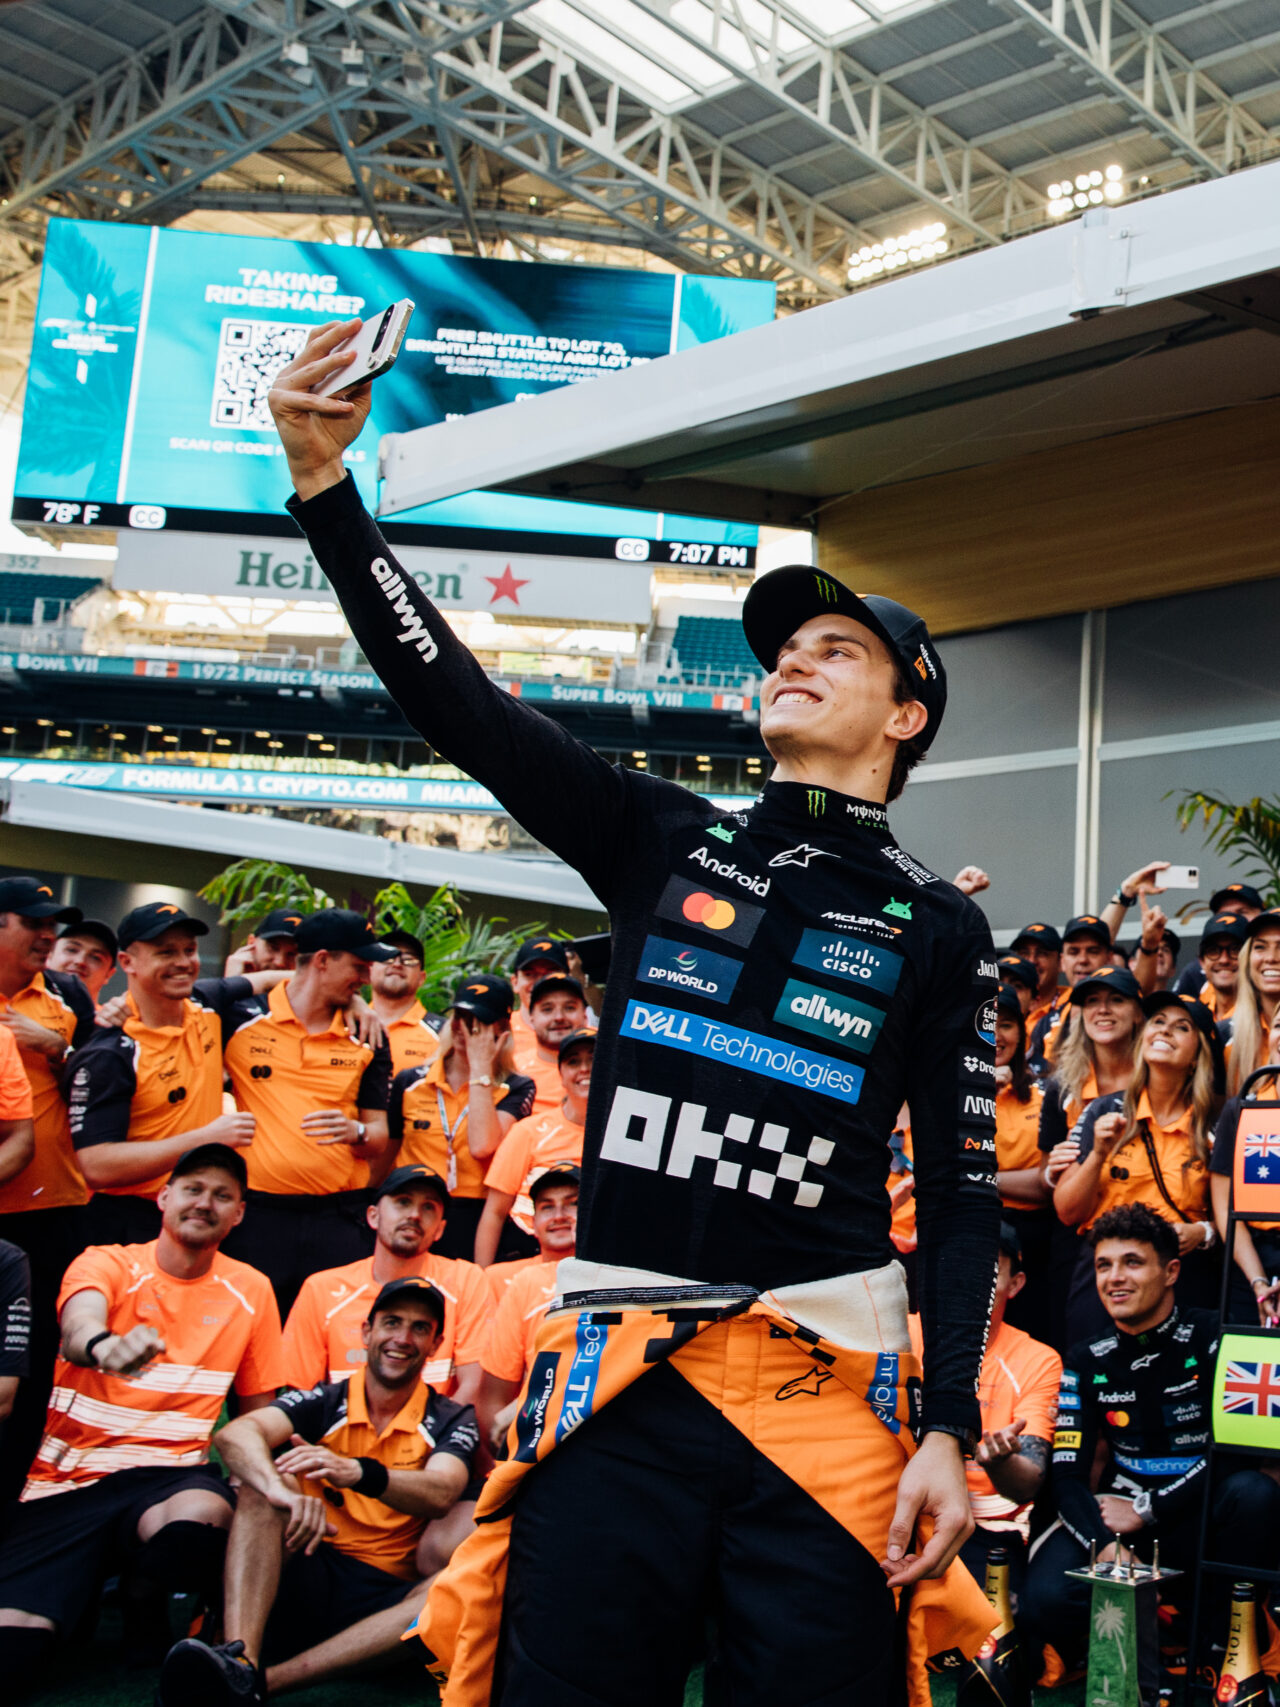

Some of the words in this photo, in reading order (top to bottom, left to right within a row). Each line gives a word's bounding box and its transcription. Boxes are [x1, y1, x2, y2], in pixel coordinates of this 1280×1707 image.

[239, 267, 338, 294] TAKING
[205, 284, 366, 315] RIDESHARE?
[405, 338, 496, 358] BRIGHTLINE
[497, 346, 563, 363] STATION
[564, 352, 599, 366] AND
[600, 354, 630, 368] LOT
[437, 328, 477, 343] FREE
[477, 331, 547, 349] SHUTTLE
[548, 337, 570, 351] TO
[571, 339, 601, 353] LOT
[169, 437, 210, 452] SCAN
[212, 440, 234, 453] QR
[235, 441, 274, 456] CODE
[83, 504, 101, 524] F
[6, 556, 40, 570] 352
[669, 542, 712, 564] 7:07
[717, 545, 748, 567] PM
[236, 550, 463, 600] Heien
[370, 556, 440, 664] allwyn
[192, 665, 240, 682] 1972
[122, 768, 240, 795] FORMULA
[242, 776, 255, 794] 1
[258, 776, 408, 803] CRYPTO.COM
[846, 803, 887, 821] MONST
[688, 846, 771, 897] Android
[895, 859, 909, 873] THE
[907, 871, 926, 886] STAY
[876, 931, 895, 940] TEAM
[648, 966, 666, 980] DP
[666, 970, 718, 994] WORLD
[822, 957, 872, 980] cisco
[790, 993, 872, 1038] allwyn
[630, 1006, 692, 1043] DELL
[699, 1022, 855, 1095] Technologies
[600, 1085, 836, 1208] OKX
[534, 1367, 554, 1426] WORLD
[560, 1375, 591, 1442] ELL
[1098, 1391, 1136, 1403] Android
[1176, 1411, 1201, 1422] cisco
[1174, 1432, 1209, 1445] allwy
